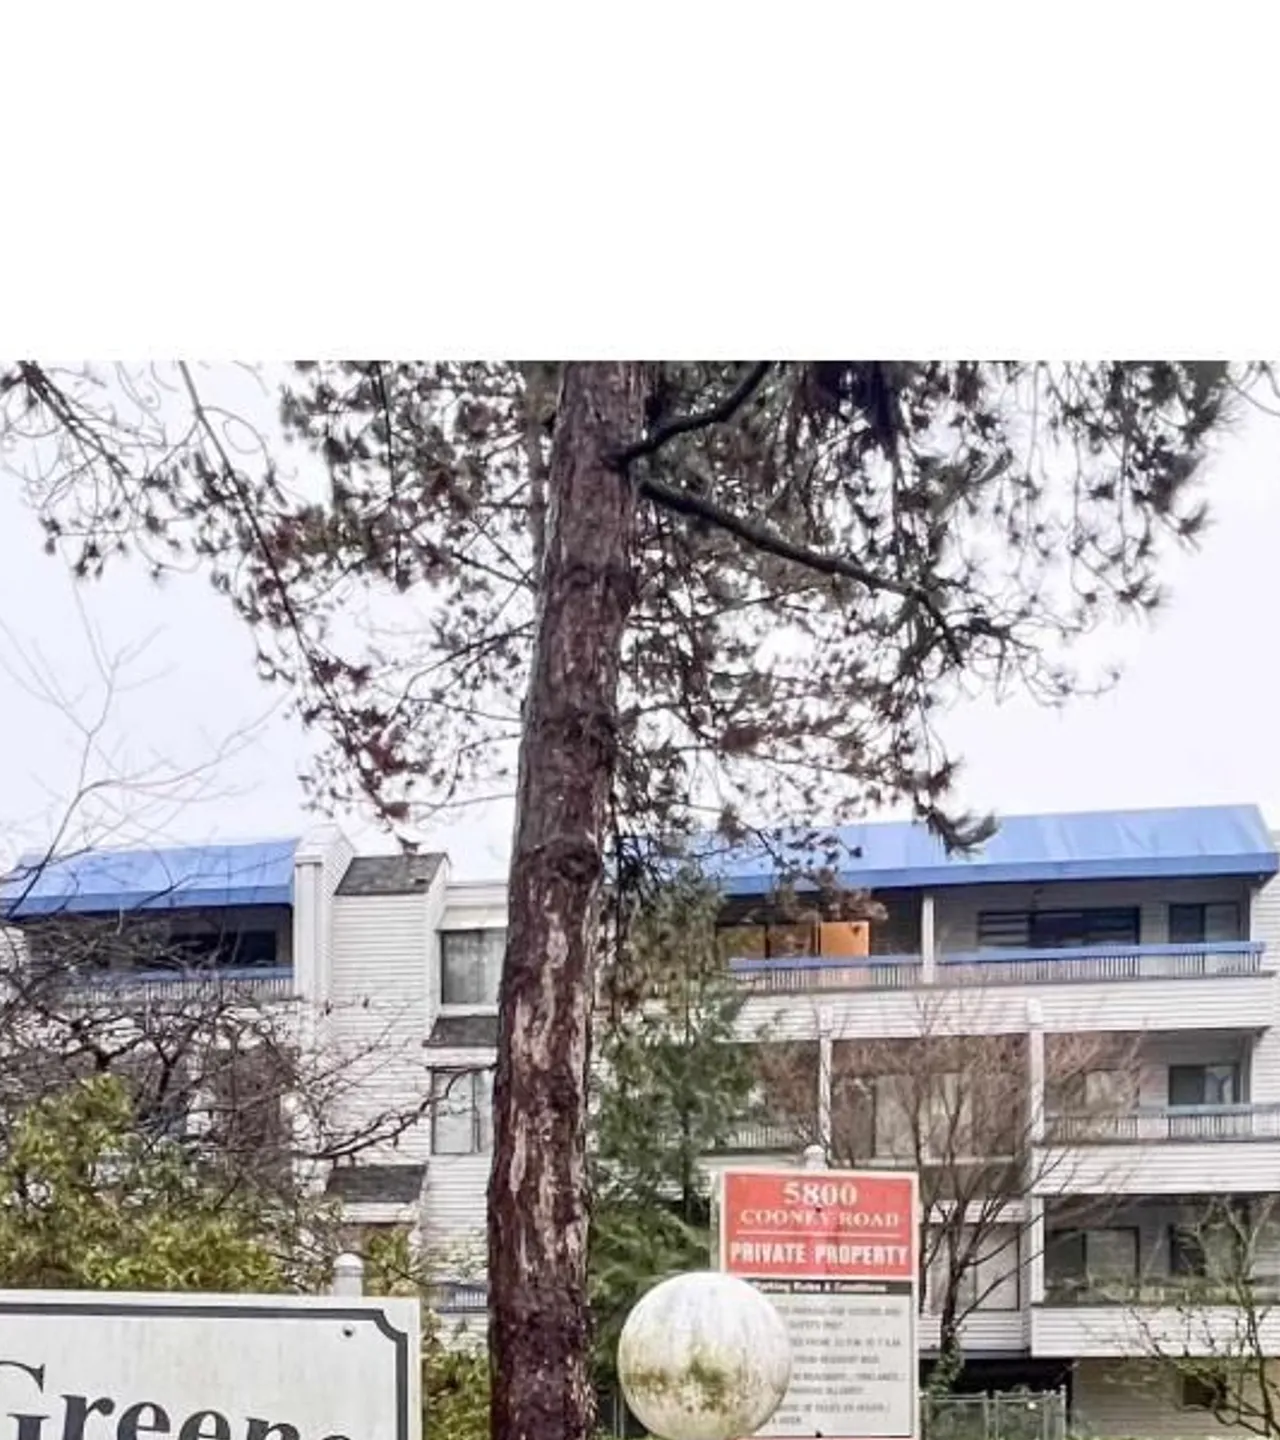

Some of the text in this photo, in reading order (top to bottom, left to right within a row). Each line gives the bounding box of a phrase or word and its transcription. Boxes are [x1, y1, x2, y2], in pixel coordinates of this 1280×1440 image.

[781, 1180, 859, 1207] 5800
[739, 1207, 899, 1228] COONEY ROAD
[730, 1240, 909, 1267] PRIVATE PROPERTY
